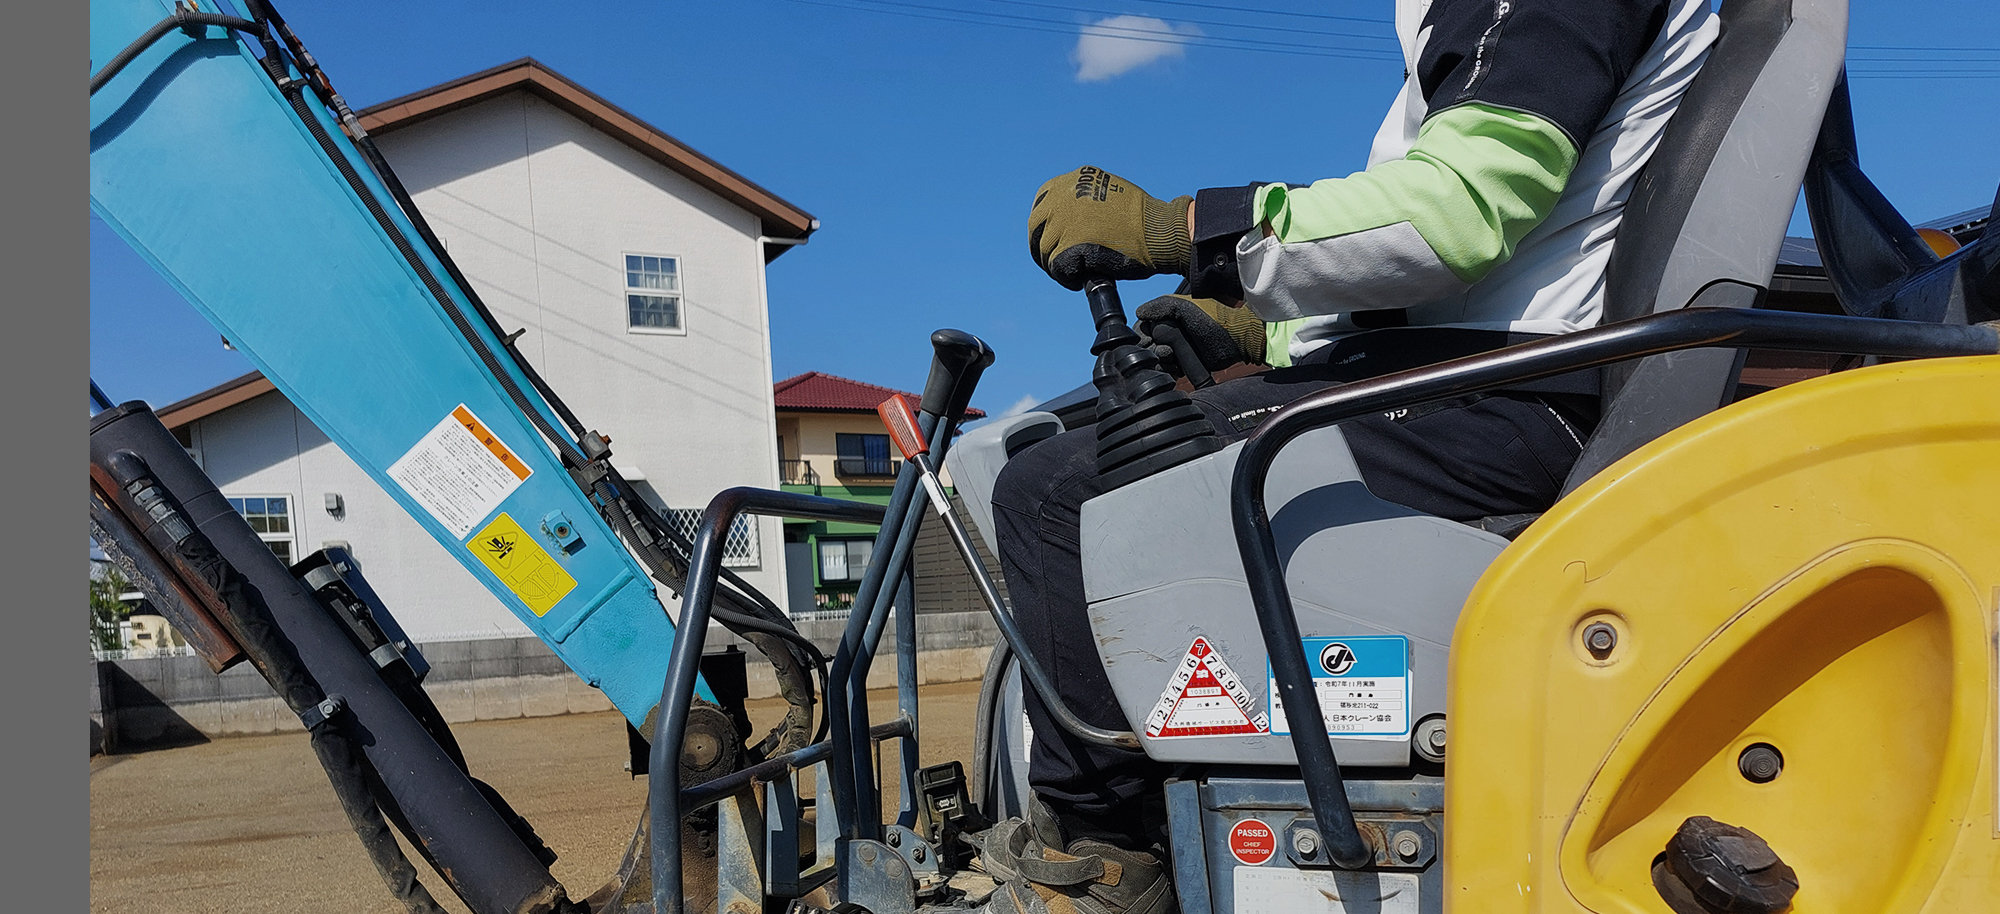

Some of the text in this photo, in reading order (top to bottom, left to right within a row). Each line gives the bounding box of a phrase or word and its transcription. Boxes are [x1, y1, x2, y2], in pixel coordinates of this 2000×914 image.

[1477, 46, 1485, 59] the
[1195, 643, 1205, 656] 7
[1149, 724, 1161, 733] 1
[1157, 709, 1168, 721] 2
[1164, 697, 1175, 708] 3
[1172, 684, 1183, 695] 4
[1178, 671, 1190, 682] 5
[1186, 657, 1197, 668] 6
[1206, 655, 1268, 729] 7 8 9 10 12
[1333, 714, 1392, 722] 日本クレーン協会
[1237, 829, 1268, 837] PASSED
